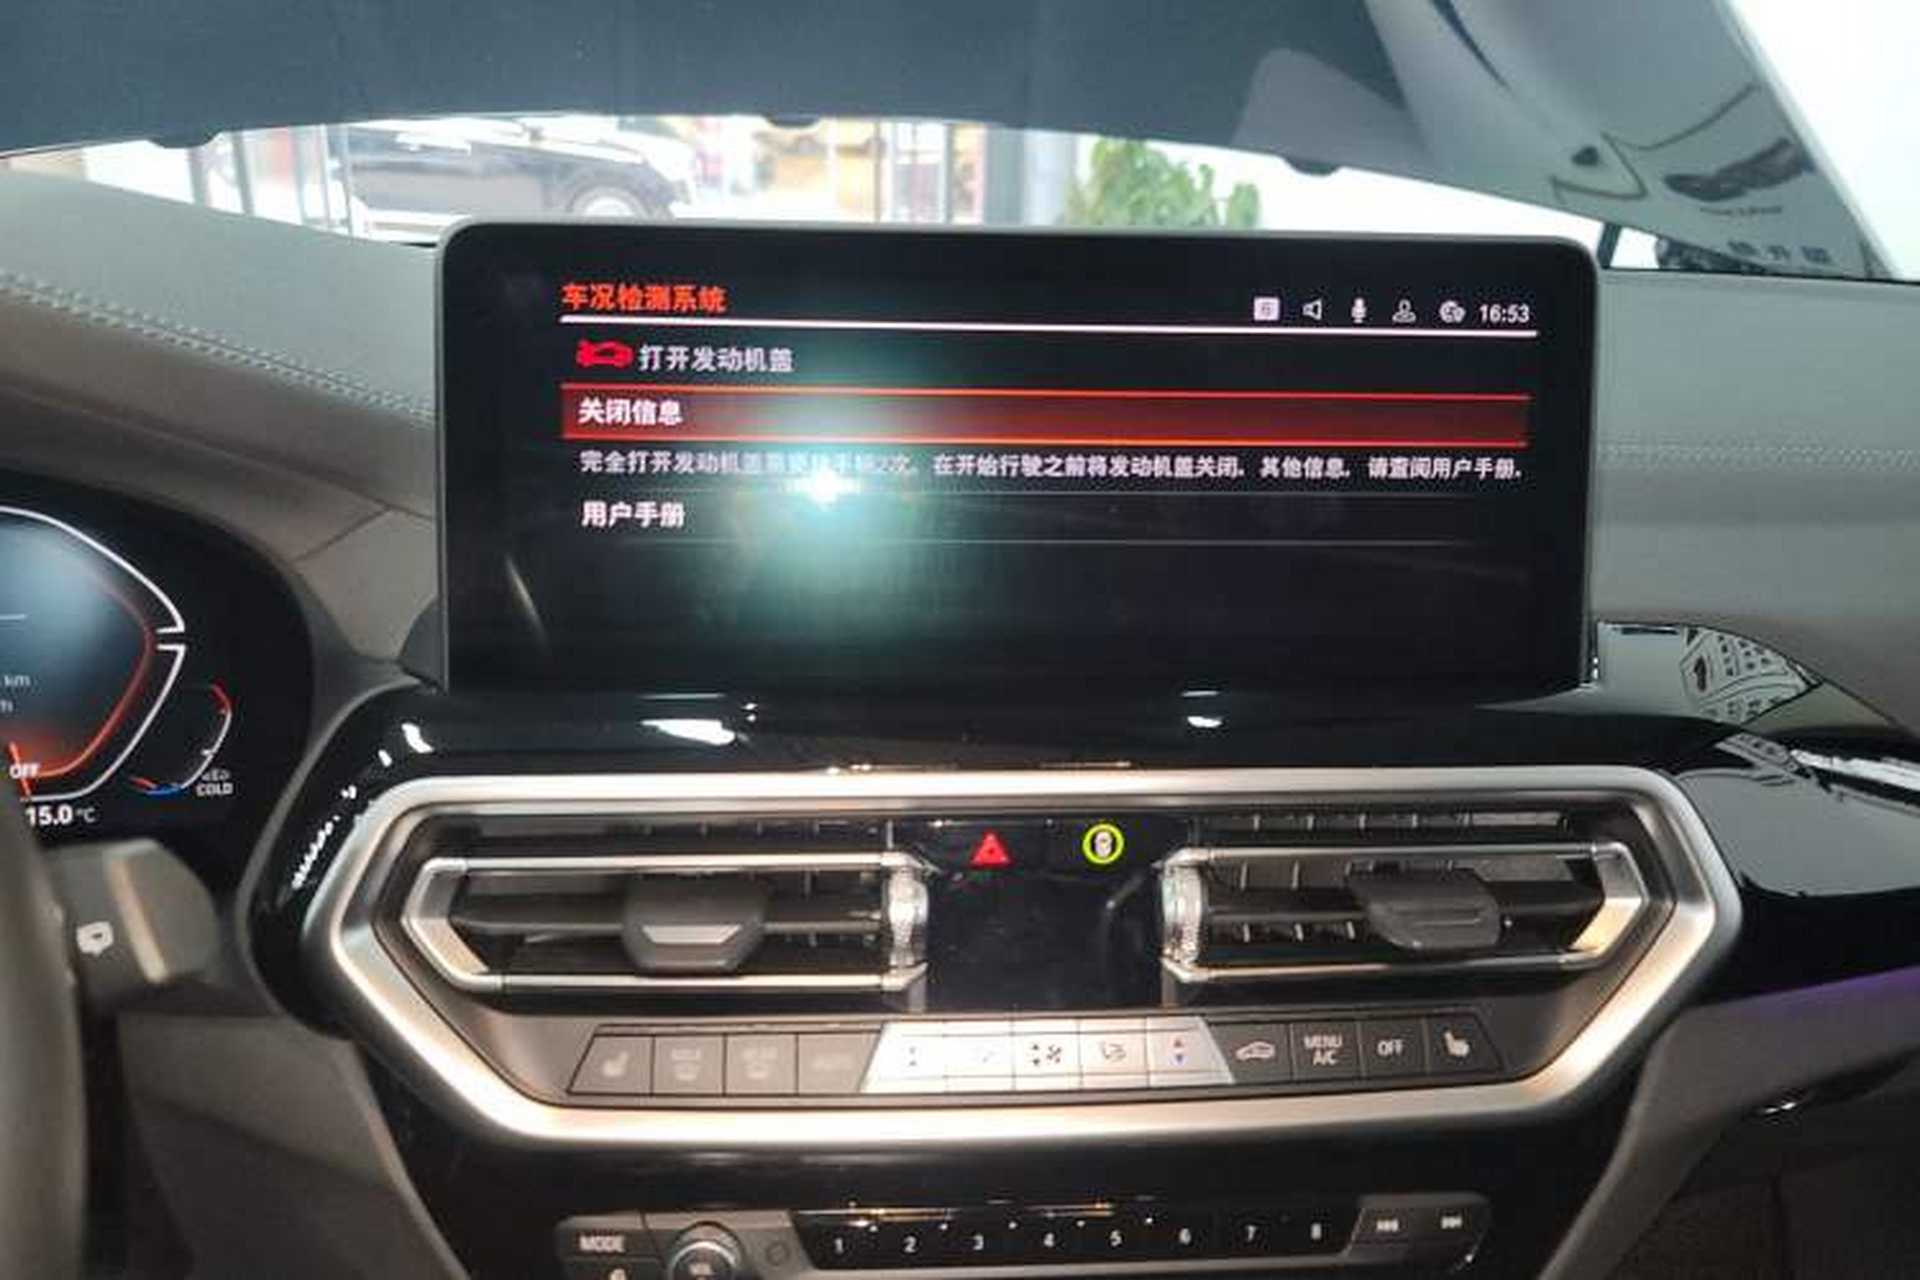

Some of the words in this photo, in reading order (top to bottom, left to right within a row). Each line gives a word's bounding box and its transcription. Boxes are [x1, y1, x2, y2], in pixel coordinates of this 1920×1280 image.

[561, 282, 728, 312] 车况检测系统
[1480, 303, 1530, 323] 16:53
[638, 344, 794, 373] 打开发动机盖
[577, 398, 683, 425] 关闭信息
[581, 501, 686, 527] 用户手册
[10, 763, 39, 779] OFF
[196, 782, 234, 797] COLD
[25, 804, 73, 827] 15.0
[1303, 1034, 1342, 1050] MENU
[1377, 1039, 1404, 1056] OFF
[1312, 1050, 1338, 1066] A/C
[834, 1238, 845, 1254] 1
[904, 1236, 917, 1252] 2
[974, 1234, 985, 1250] 3
[1044, 1232, 1056, 1248] 4
[1110, 1230, 1123, 1247] 5
[1178, 1227, 1192, 1245] 6
[1244, 1225, 1257, 1242] 7
[1310, 1223, 1323, 1240] 8
